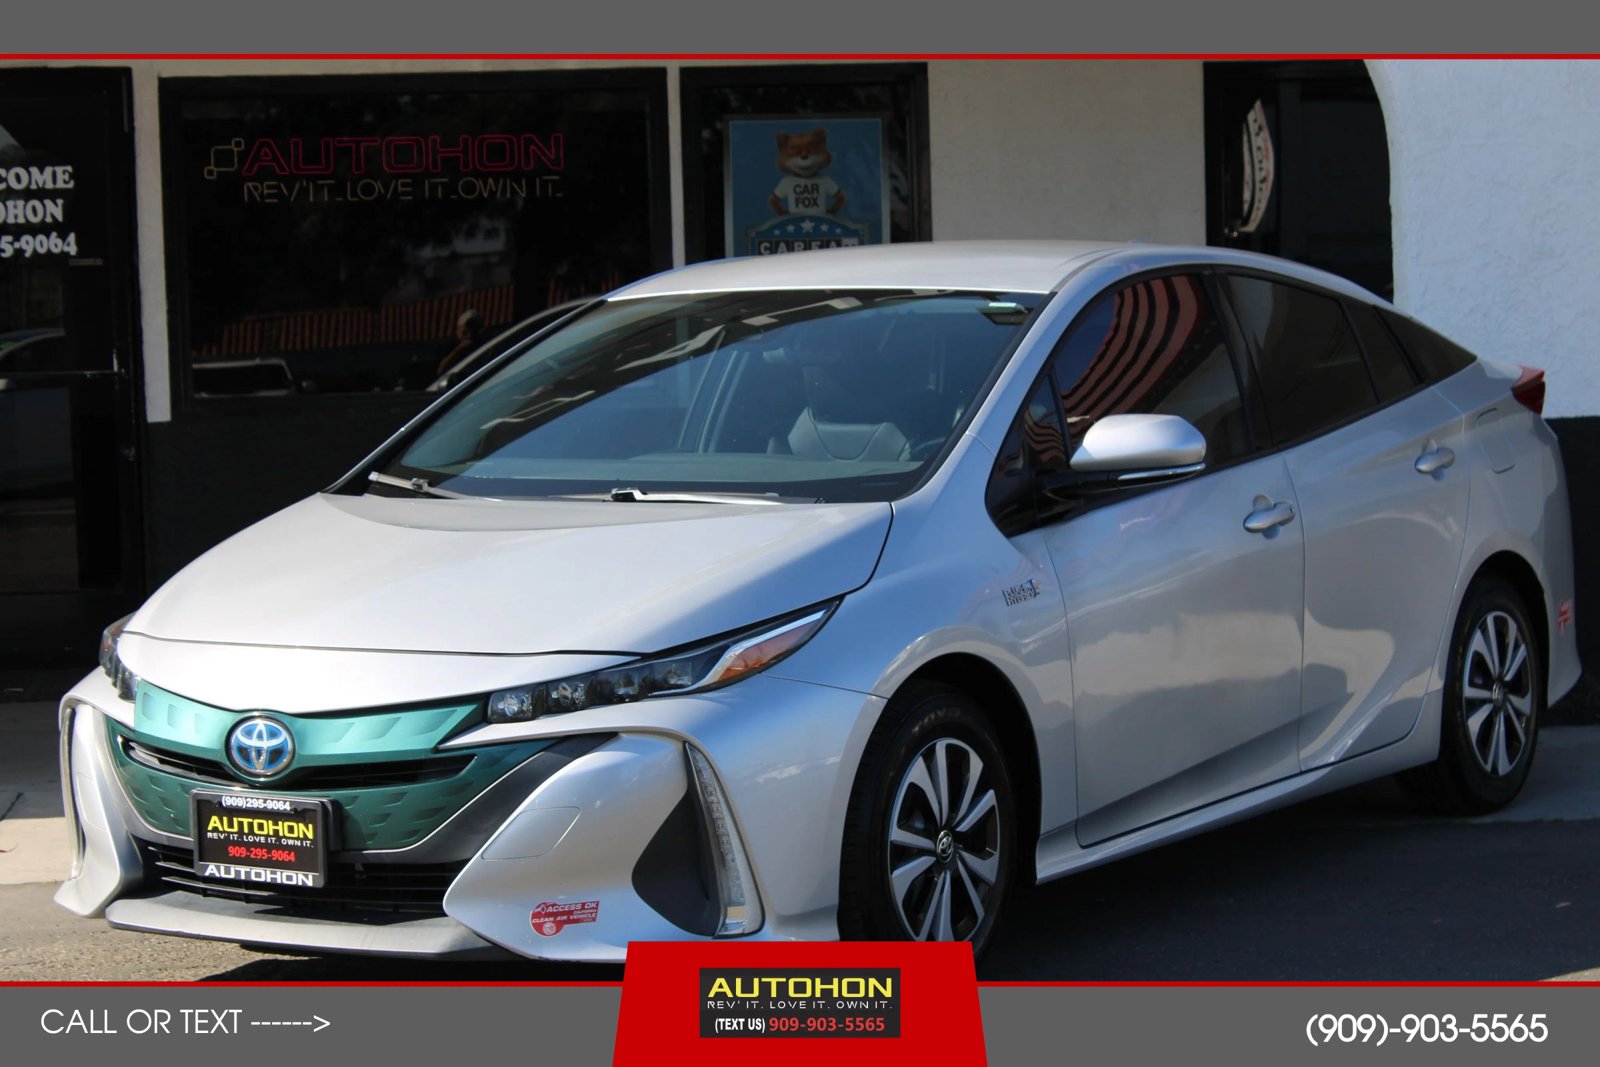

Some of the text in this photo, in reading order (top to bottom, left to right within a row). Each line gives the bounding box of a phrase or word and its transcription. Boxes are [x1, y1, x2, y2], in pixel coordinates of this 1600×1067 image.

[242, 133, 564, 176] AUTOHON
[793, 183, 820, 196] CAR
[794, 196, 820, 209] FOX
[221, 795, 291, 811] (909)295-9064
[207, 815, 314, 840] AUTOHON
[243, 835, 266, 844] LOVE
[281, 838, 301, 847] OWN
[228, 846, 295, 862] 909-295-9064
[205, 864, 313, 887] AUTOHON
[546, 903, 582, 912] ACCESS
